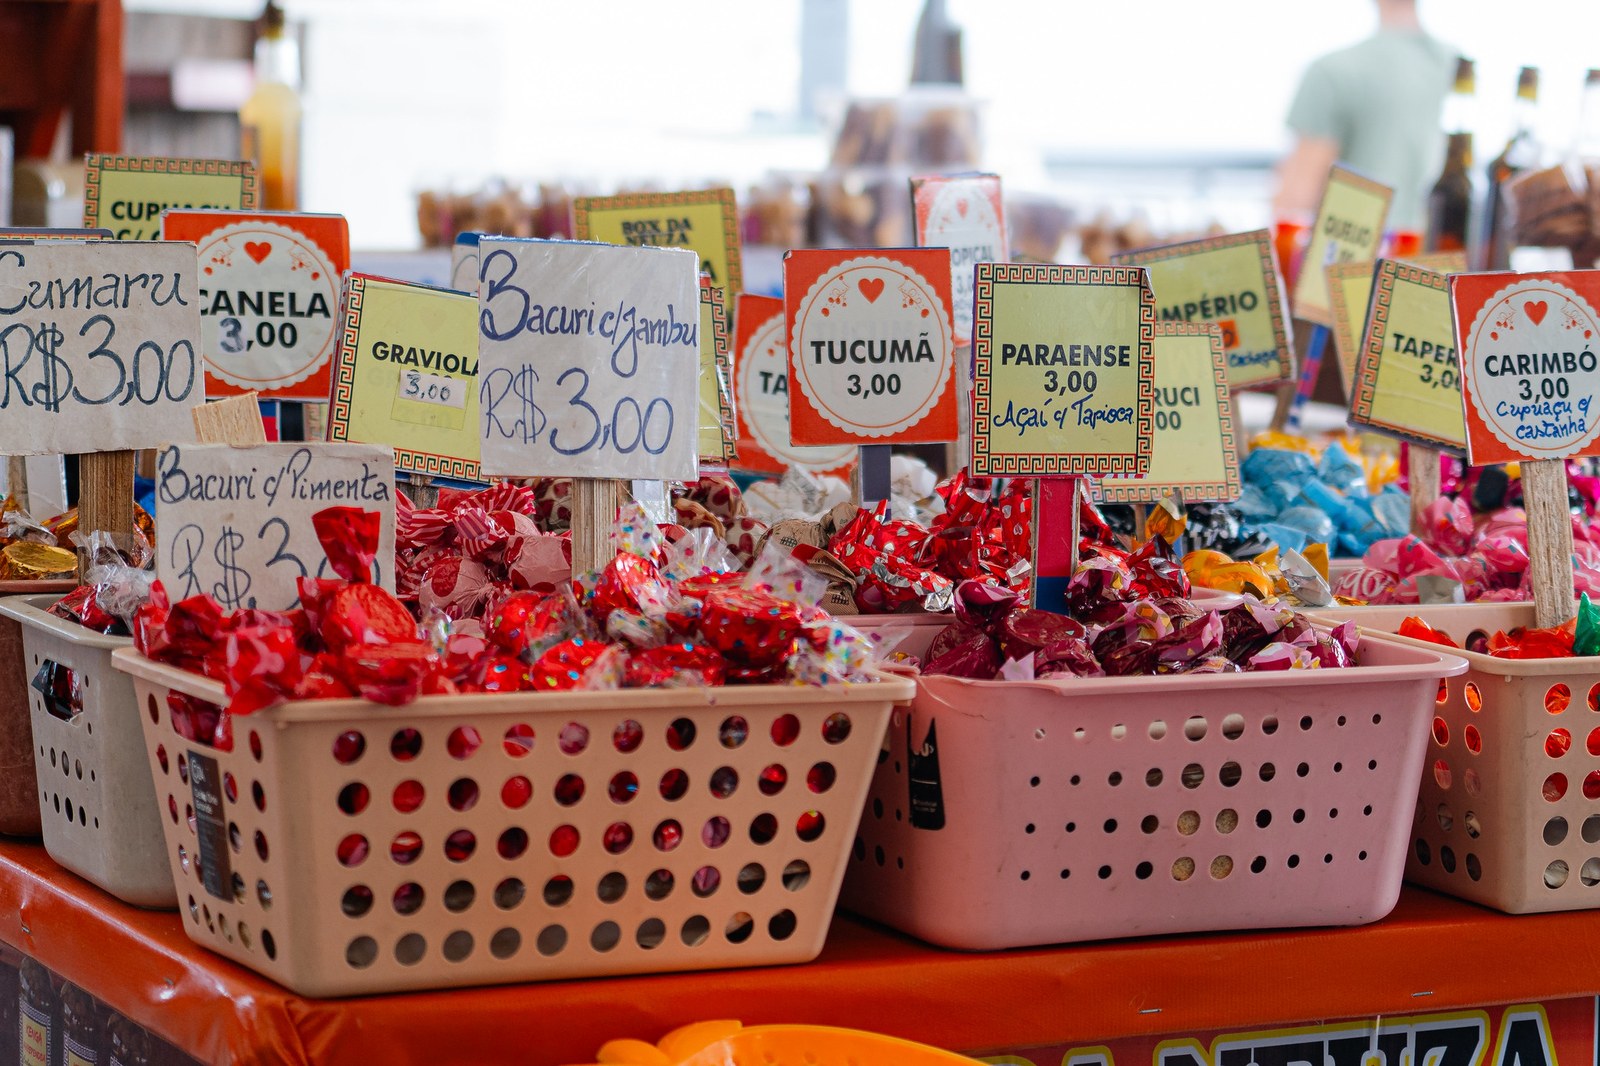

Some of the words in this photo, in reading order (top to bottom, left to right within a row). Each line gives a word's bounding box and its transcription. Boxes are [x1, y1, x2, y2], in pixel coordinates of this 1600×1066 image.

[0, 251, 188, 315] Cumaru
[480, 249, 595, 341] Bacuri
[220, 318, 298, 353] 3,00
[811, 332, 935, 364] TUCUMÃ
[1001, 343, 1131, 367] PARAENSE
[1484, 344, 1597, 377] CARIMBÓ
[405, 373, 451, 401] 3,00
[847, 373, 901, 399] 3,00
[1044, 370, 1097, 396] 3,00
[1518, 377, 1569, 403] 3,00
[993, 398, 1048, 436] Açaí
[159, 445, 256, 504] Bacuri
[286, 449, 390, 501] Pimenta
